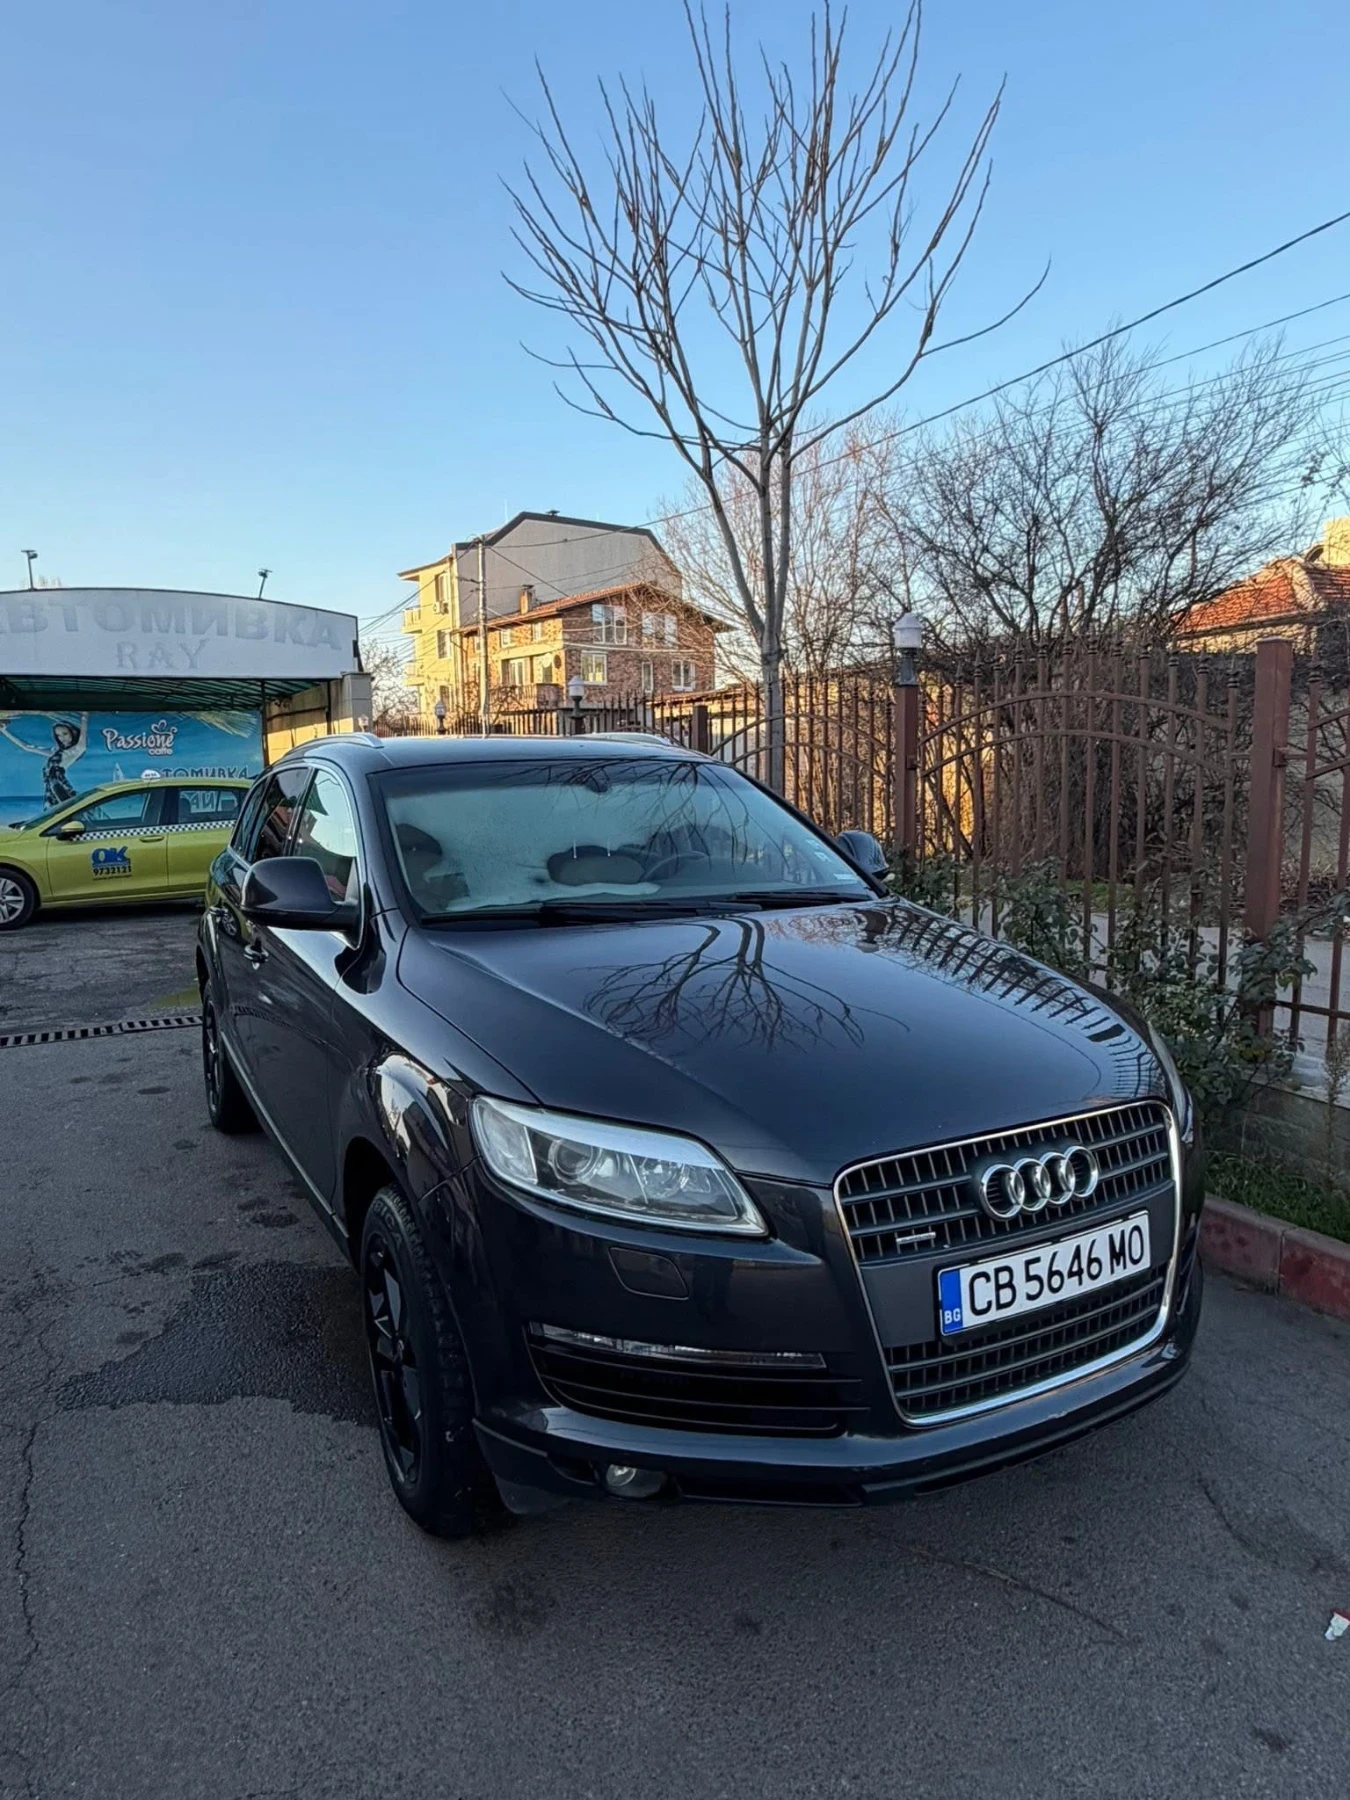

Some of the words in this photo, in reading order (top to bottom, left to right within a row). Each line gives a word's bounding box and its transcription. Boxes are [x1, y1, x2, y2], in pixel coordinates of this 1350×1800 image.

[0, 602, 344, 650] ВТОМИВКА
[116, 638, 210, 669] RAY
[103, 727, 177, 751] Passione
[93, 866, 131, 876] 9732121
[969, 1265, 1017, 1316] CB
[1024, 1239, 1102, 1301] 5646
[1108, 1225, 1144, 1275] MO
[944, 1308, 961, 1324] BG
